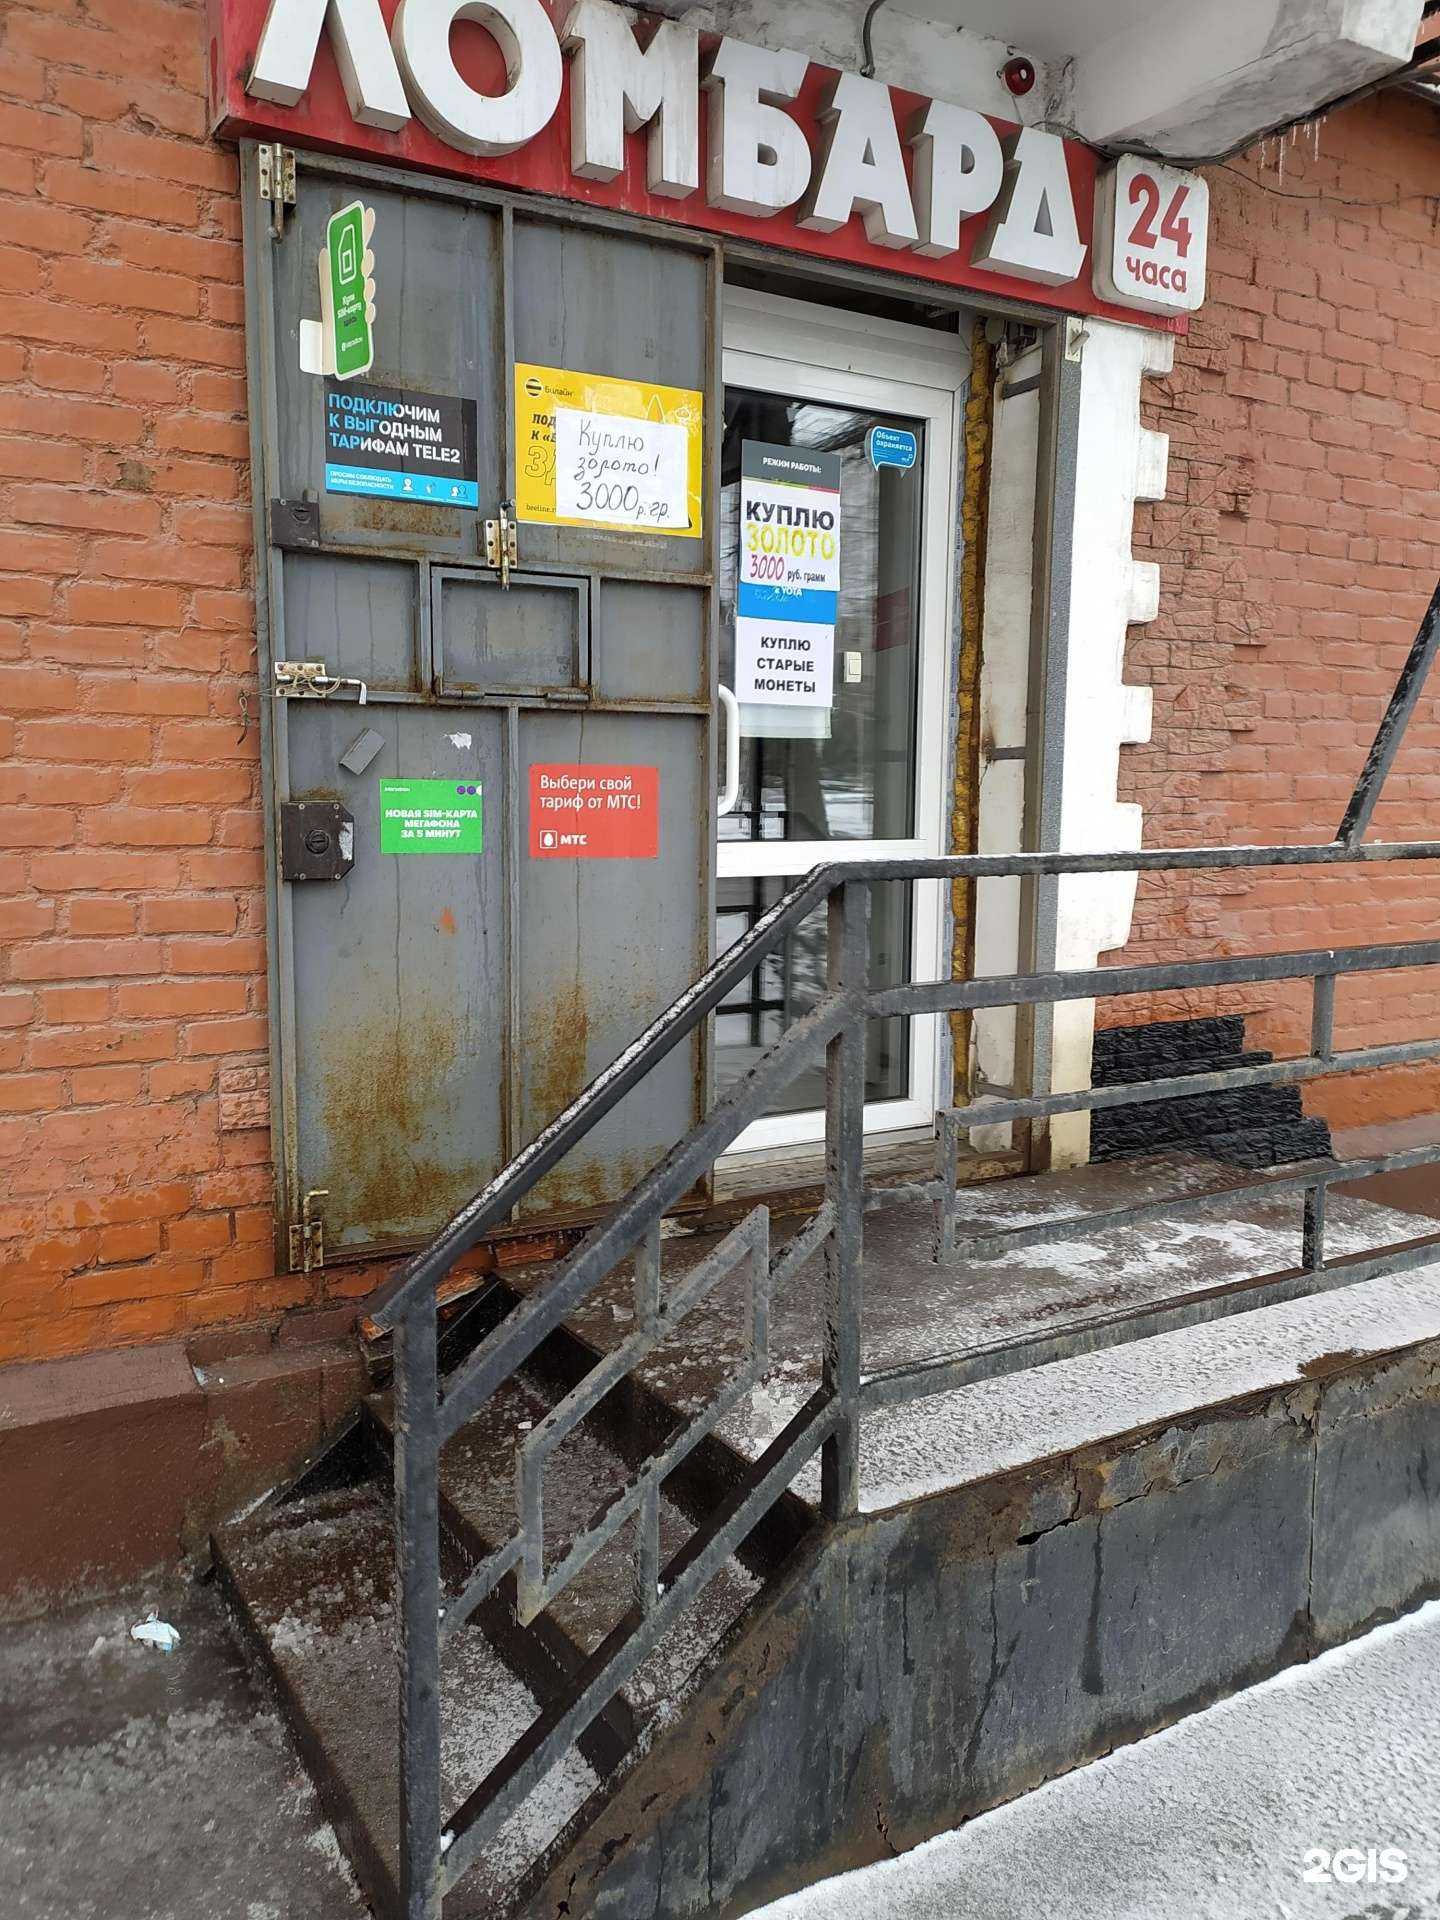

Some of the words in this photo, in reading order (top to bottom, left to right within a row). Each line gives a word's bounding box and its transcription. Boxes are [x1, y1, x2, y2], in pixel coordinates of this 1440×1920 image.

[245, 0, 1088, 285] ЛОМБАРД
[1128, 173, 1192, 258] 24
[1126, 255, 1188, 294] часа
[328, 393, 440, 424] ПОДКЛЮЧИМ
[329, 413, 340, 428] К
[344, 415, 442, 443] ВЫГОДНЫМ
[579, 418, 644, 456] Куплю
[329, 432, 409, 457] ТАРИФАМ
[412, 443, 461, 464] TELE2
[875, 439, 913, 452] охраняется
[762, 456, 790, 469] РЕЖИМ
[791, 461, 822, 473] РАБОТЫ:
[576, 481, 639, 511] 3000
[746, 500, 835, 531] КУПЛЮ
[746, 523, 835, 561] ЗОЛОТО
[750, 553, 785, 582] 3000
[803, 571, 825, 583] грамм
[760, 636, 811, 651] КУПЛЮ
[756, 657, 815, 672] СТАРЫЕ
[754, 678, 816, 693] МОНЕТЫ
[540, 774, 596, 792] Выбери
[599, 775, 632, 790] свой
[385, 809, 422, 818] НОВАЯ
[423, 809, 478, 818] SIM-КАРТА
[540, 793, 584, 812] тариф
[588, 797, 602, 809] от
[607, 794, 641, 810] МТС!
[401, 829, 414, 838] ЗА
[416, 829, 424, 838] 5
[425, 829, 462, 838] МИНУТ
[404, 819, 460, 828] МЕГАФОНА
[560, 834, 588, 845] МТС
